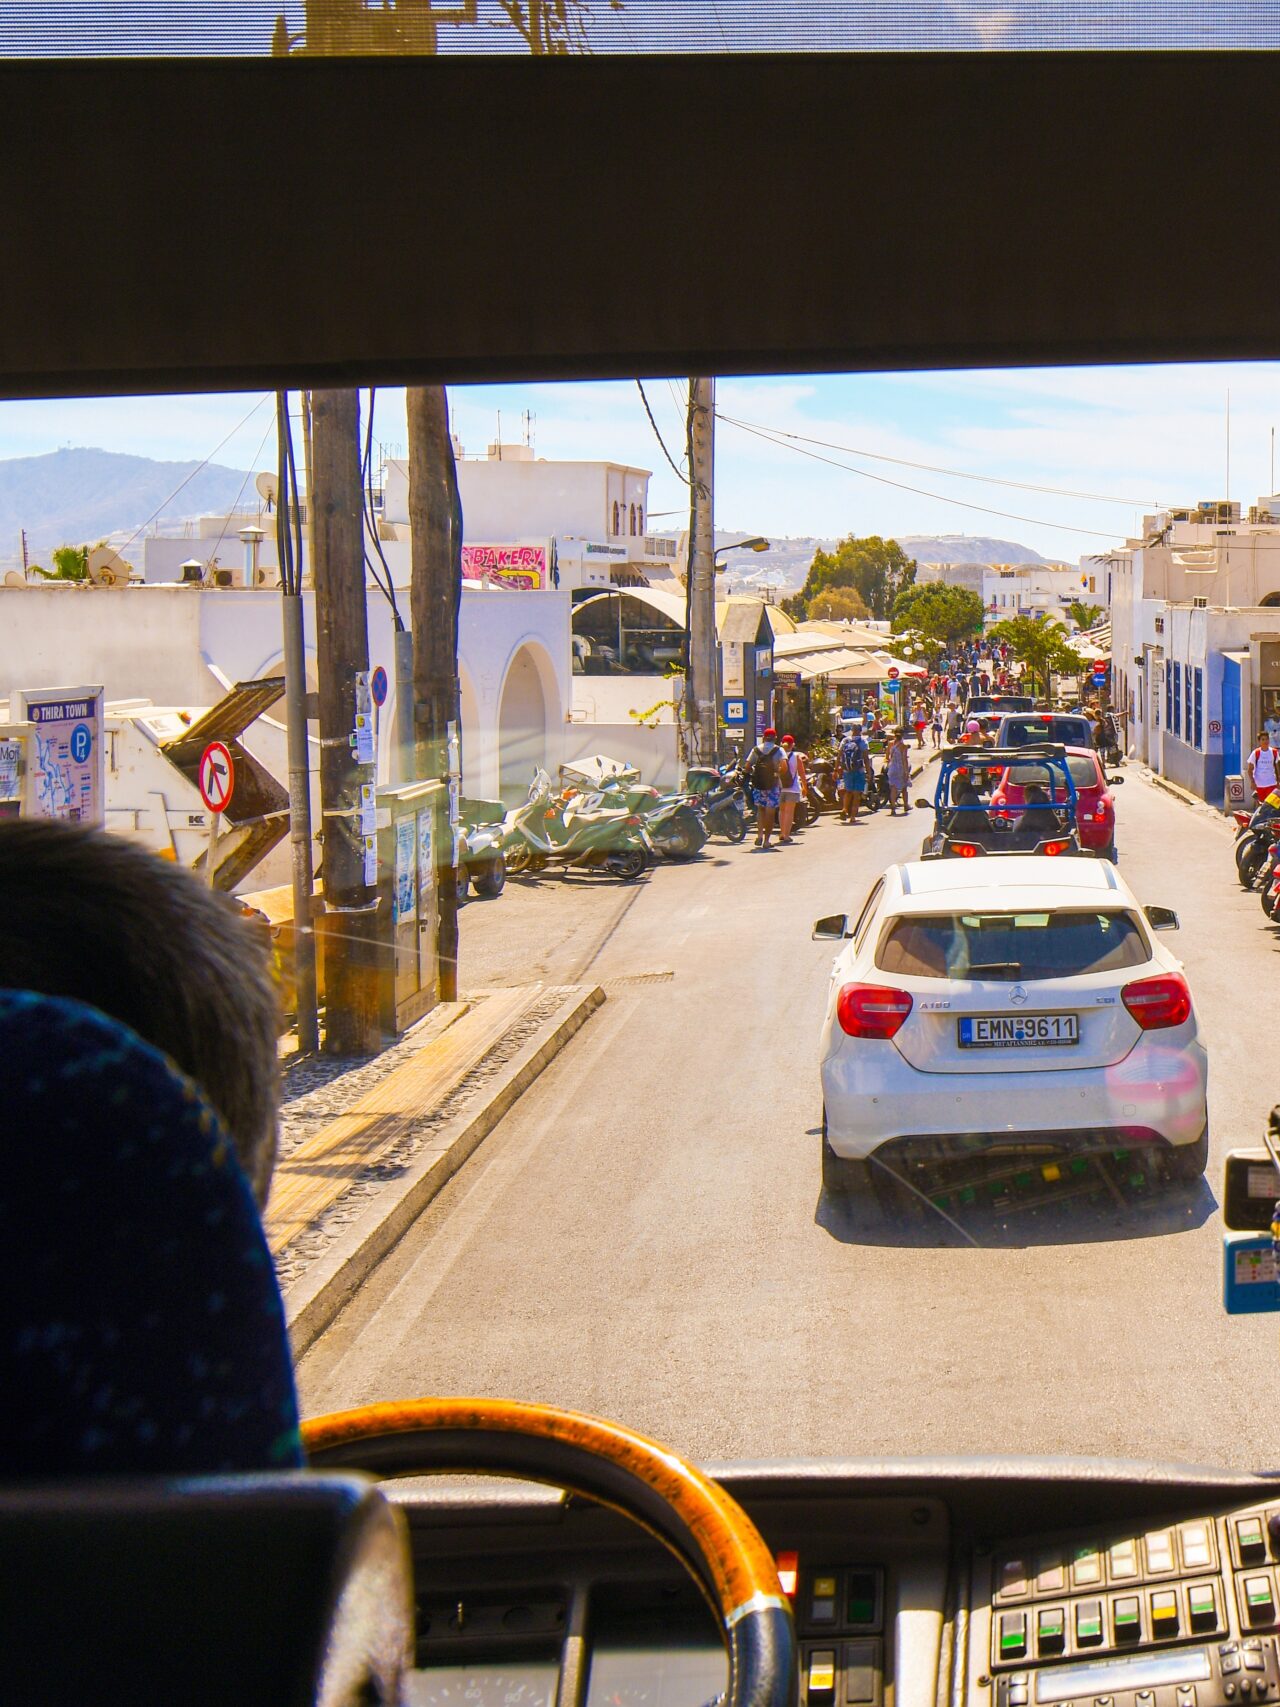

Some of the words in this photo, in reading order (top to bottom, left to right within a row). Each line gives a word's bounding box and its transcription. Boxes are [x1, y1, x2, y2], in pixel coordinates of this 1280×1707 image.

[473, 549, 542, 566] BAKERY
[41, 705, 64, 720] THIRA
[66, 703, 87, 718] TOWN
